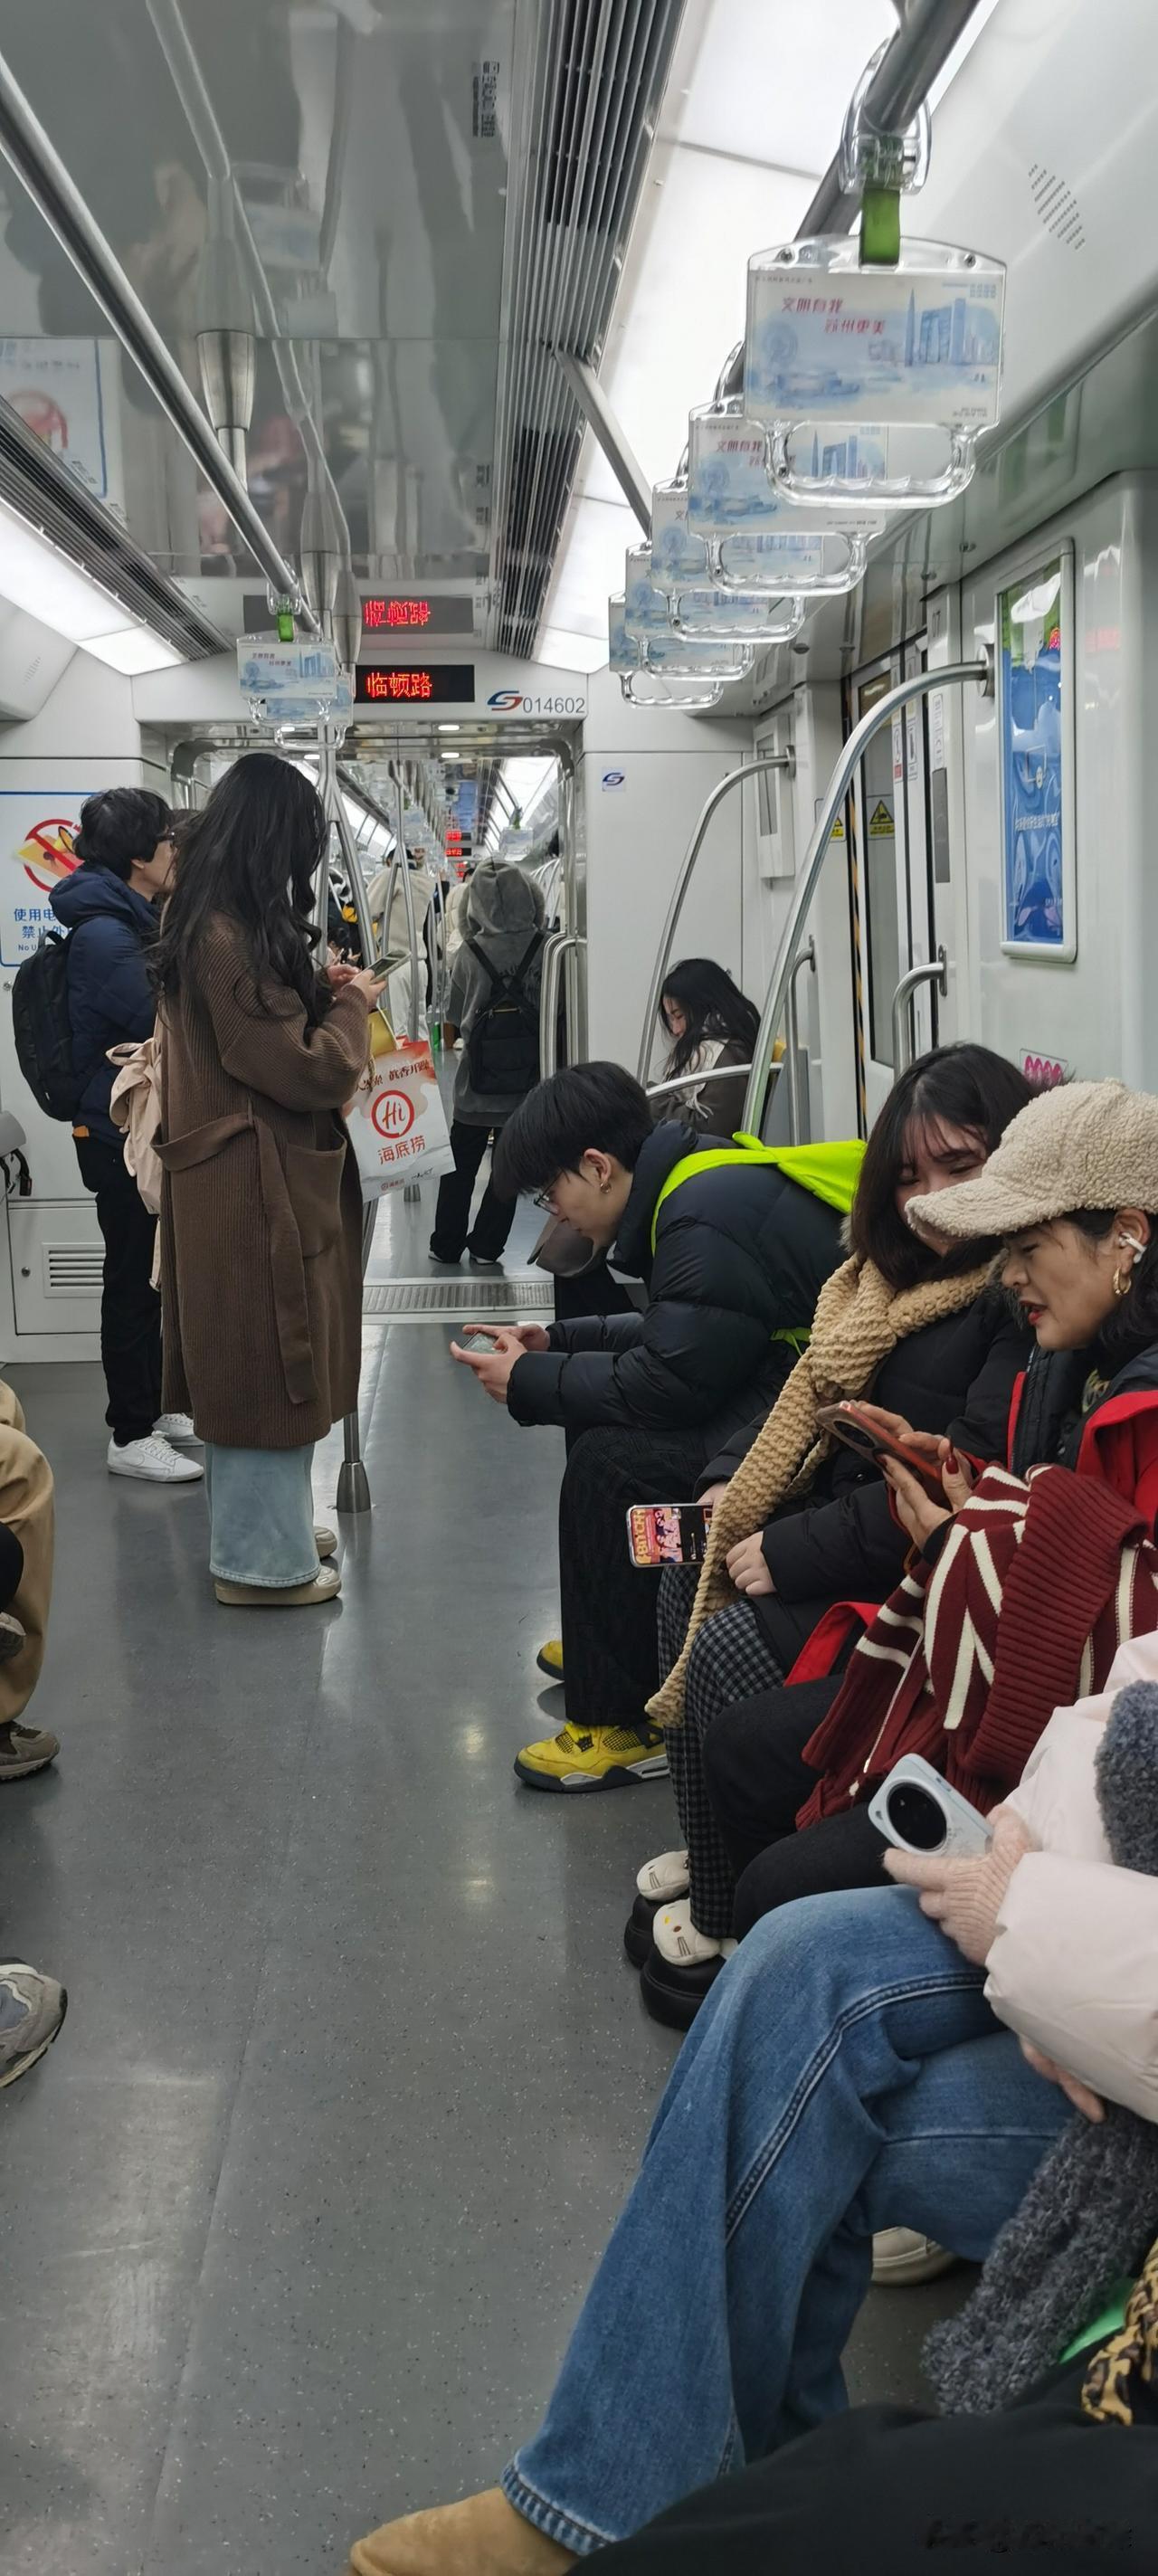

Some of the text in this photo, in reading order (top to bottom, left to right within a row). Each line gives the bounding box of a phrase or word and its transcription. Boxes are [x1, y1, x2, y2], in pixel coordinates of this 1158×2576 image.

[782, 297, 844, 313] 文明有我
[366, 671, 432, 698] 临顿路
[522, 698, 585, 714] 014602
[383, 1101, 405, 1129] Hi
[377, 1135, 425, 1165] 海底捞
